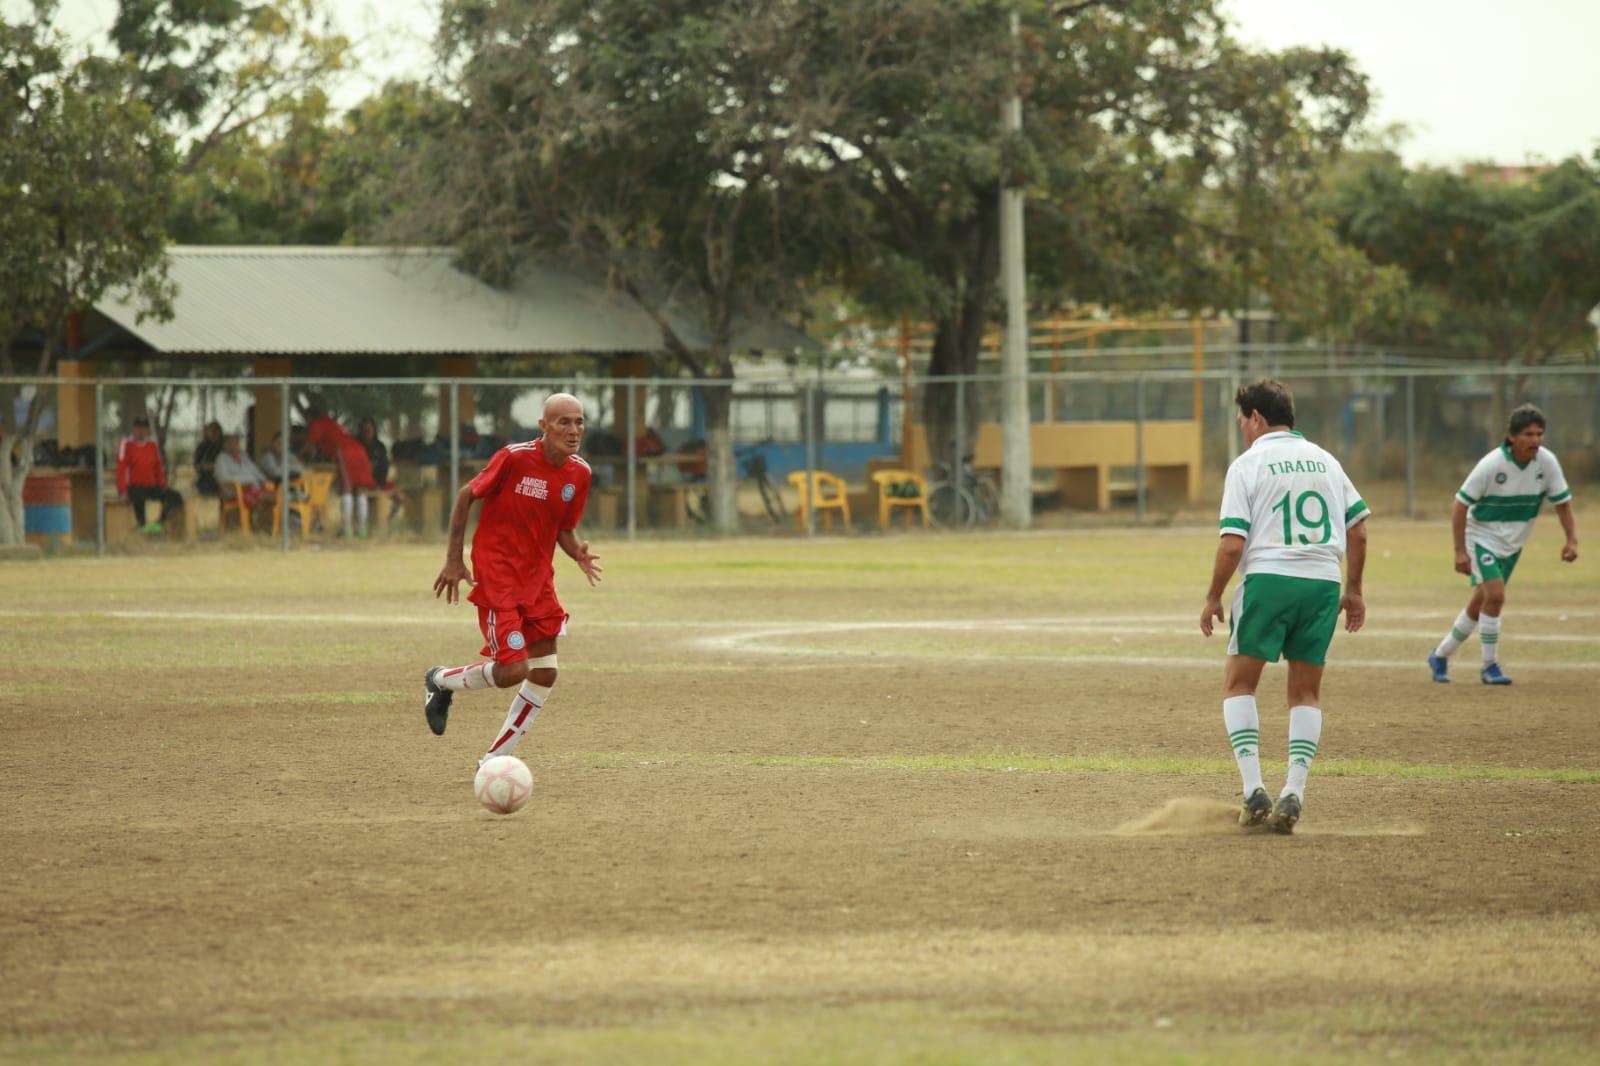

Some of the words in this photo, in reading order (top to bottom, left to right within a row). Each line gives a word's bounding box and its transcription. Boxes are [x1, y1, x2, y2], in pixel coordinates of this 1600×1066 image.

[1268, 460, 1326, 475] TIRADO
[515, 483, 522, 494] DE
[521, 476, 548, 489] AMIGOS
[1272, 490, 1331, 545] 19
